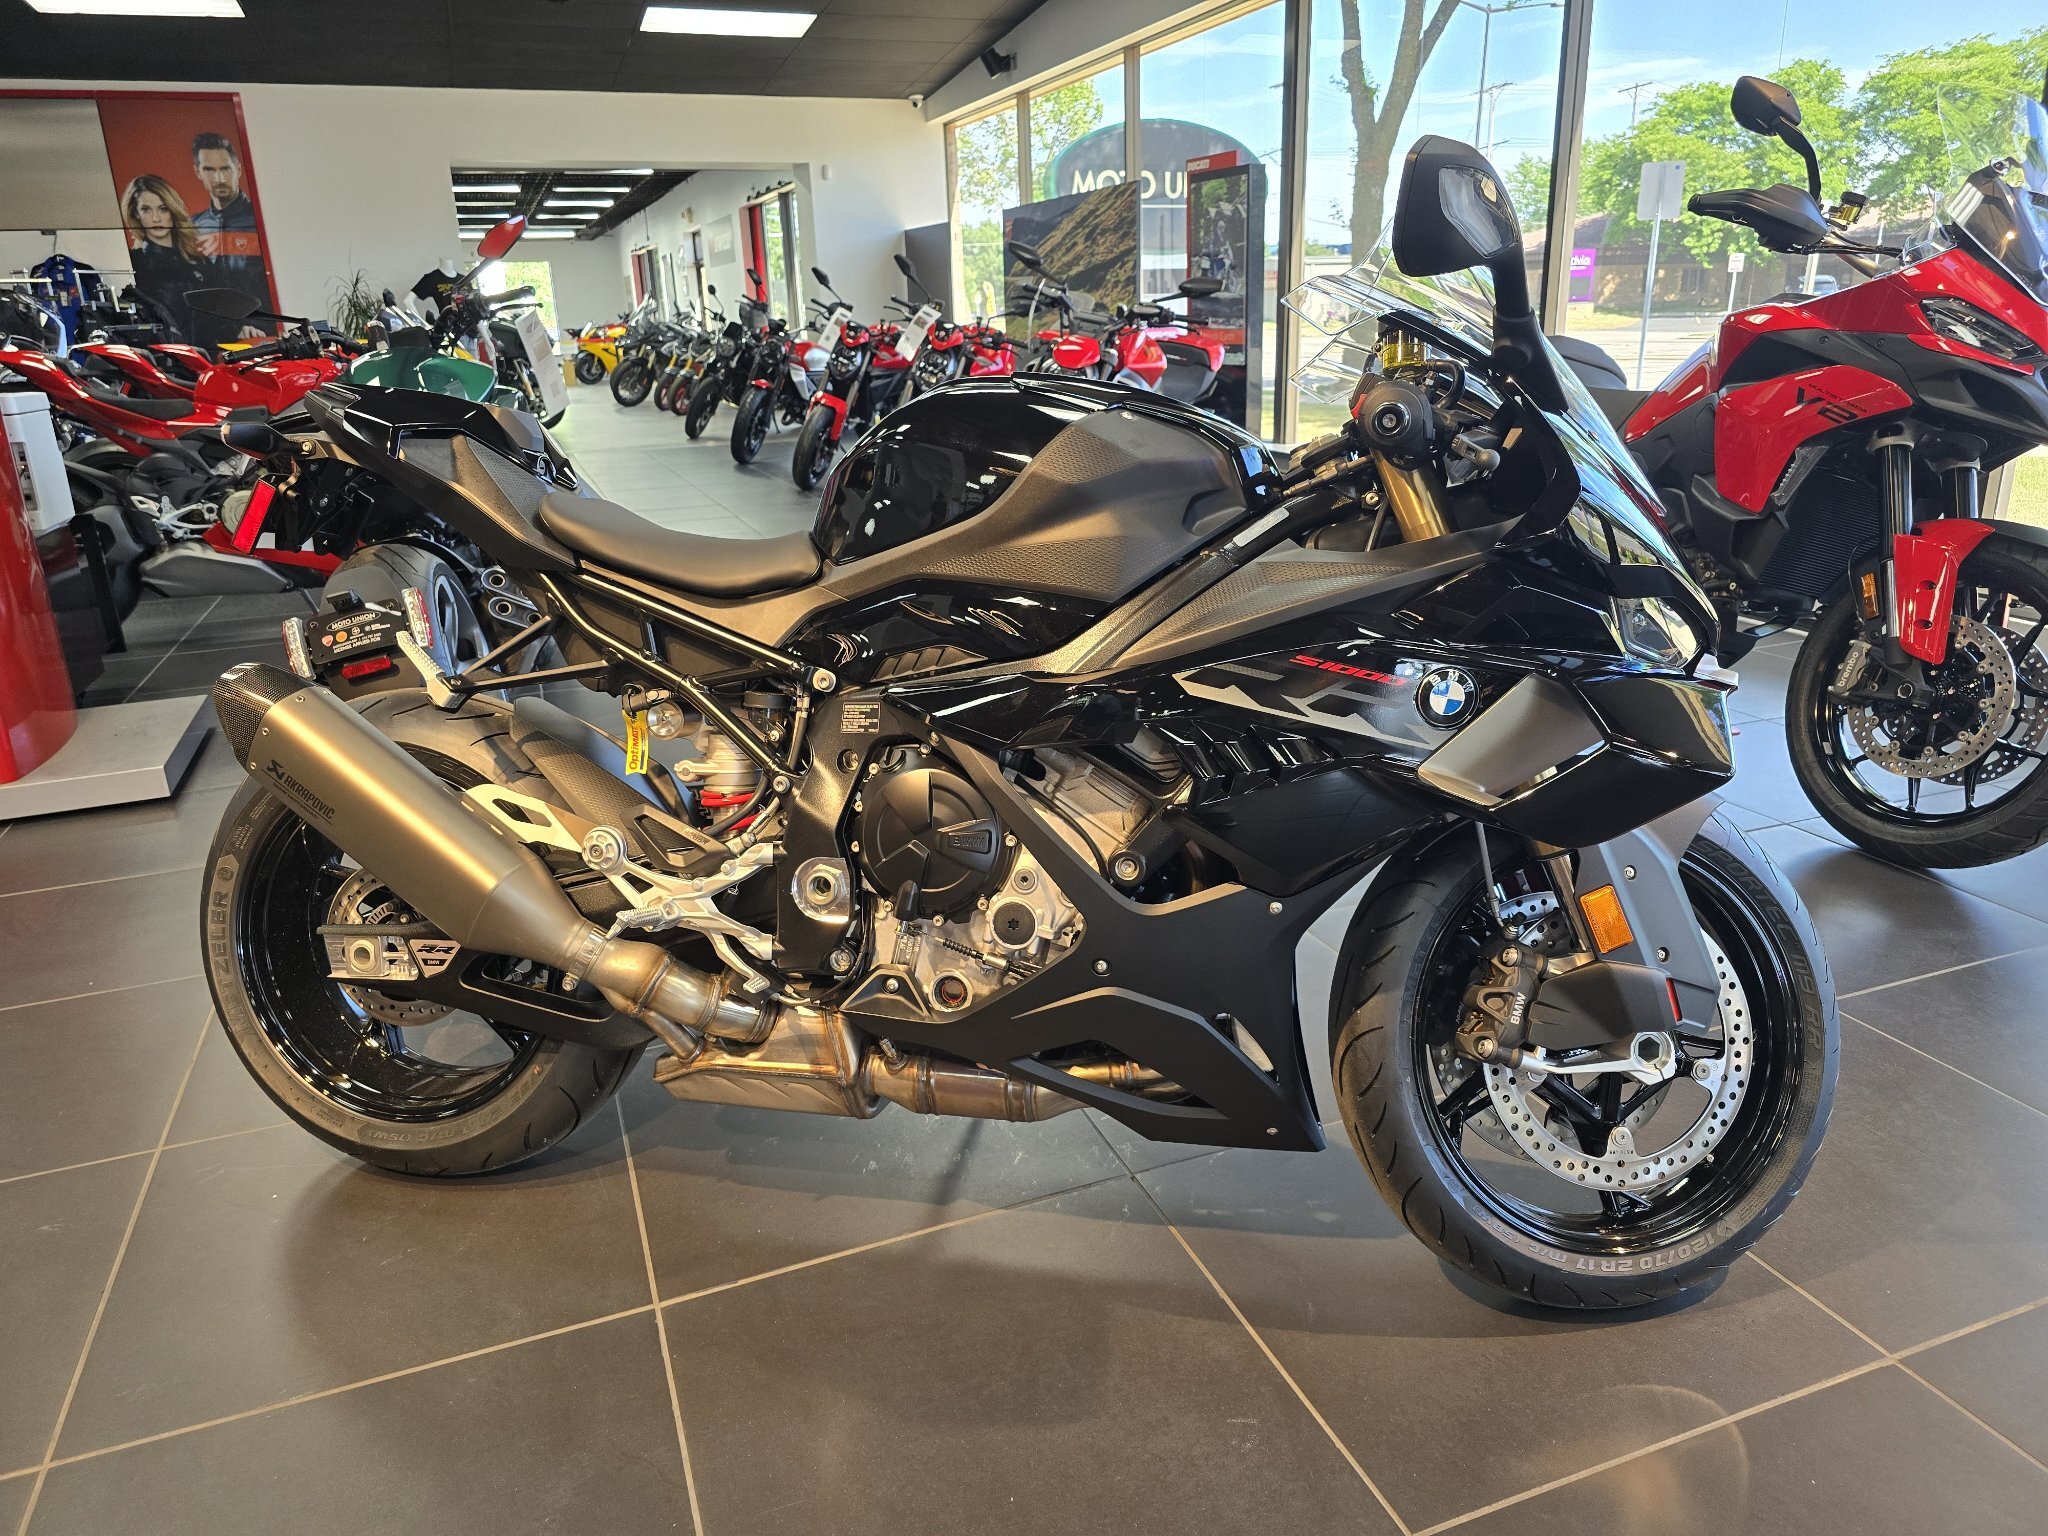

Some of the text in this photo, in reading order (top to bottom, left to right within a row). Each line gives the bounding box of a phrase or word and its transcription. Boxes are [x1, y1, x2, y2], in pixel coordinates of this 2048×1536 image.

[1072, 169, 1157, 199] MOO
[331, 612, 376, 629] MOTO UNION
[1289, 655, 1409, 687] S1000
[1837, 651, 1859, 687] brembo
[1509, 991, 1526, 1025] BMW
[1639, 1234, 1716, 1269] 120/70
